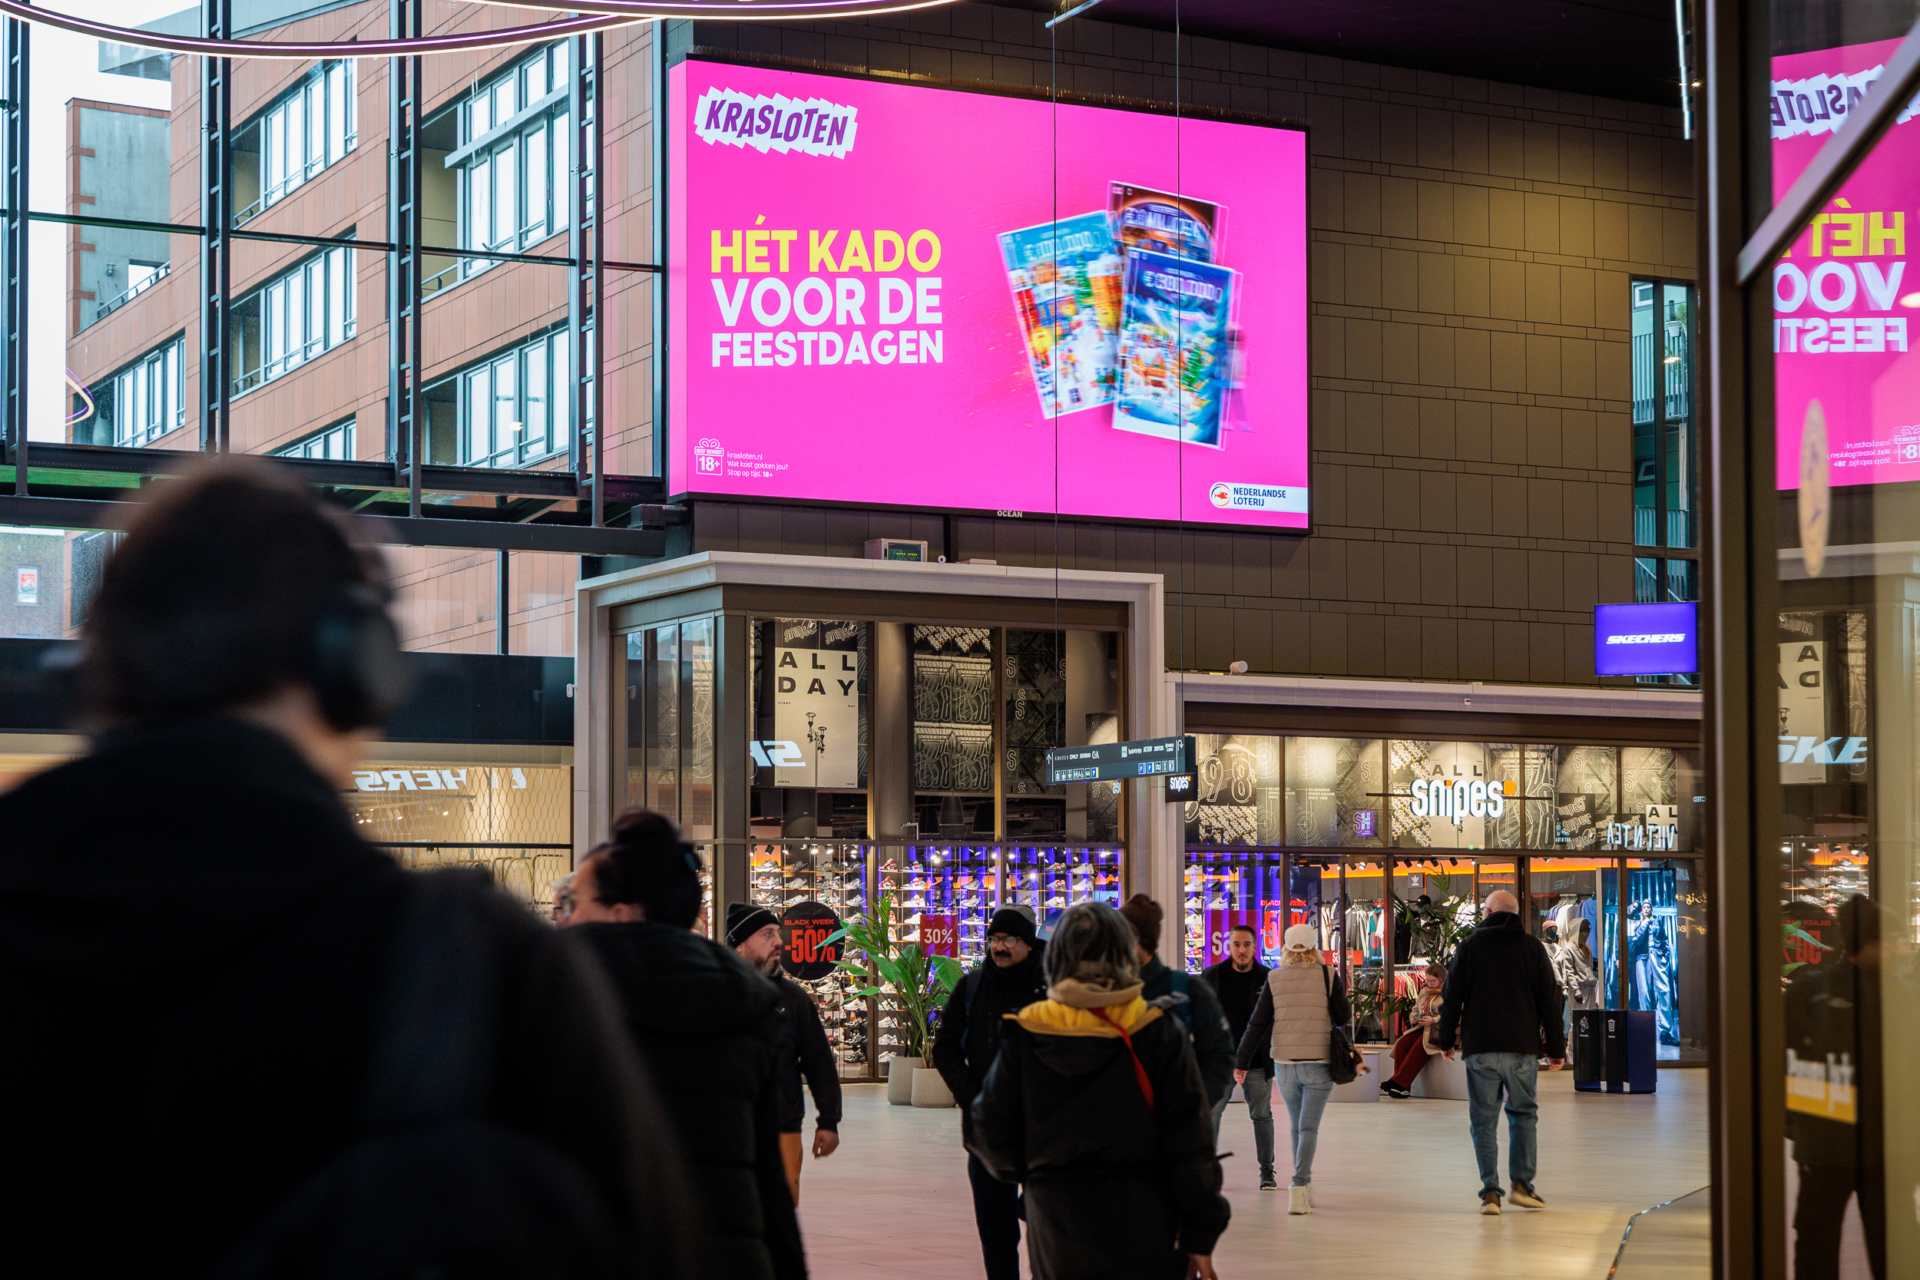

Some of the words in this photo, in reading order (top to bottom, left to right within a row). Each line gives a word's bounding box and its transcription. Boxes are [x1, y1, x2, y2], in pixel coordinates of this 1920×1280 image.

[705, 99, 849, 146] KRASLOTEN
[711, 214, 798, 273] HÉT
[809, 229, 942, 273] KADO
[711, 277, 867, 327] VOOR
[879, 277, 943, 325] DE
[712, 329, 944, 368] FEESTDAGEN
[699, 456, 720, 471] 18+
[727, 451, 763, 460] krasloten.nl
[727, 469, 741, 477] Stop
[754, 462, 775, 470] gokken
[1233, 487, 1287, 498] NEDERLANDSE
[1233, 497, 1265, 506] LOTERIJ
[997, 510, 1023, 518] OCEAN
[1606, 633, 1686, 644] SKECHERS
[778, 651, 856, 672] ALL
[778, 676, 856, 696] DAY
[1431, 764, 1483, 777] ALL
[1170, 776, 1189, 792] snipes
[1410, 779, 1504, 826] snipes
[924, 928, 953, 944] 30%
[784, 928, 836, 963] -50%
